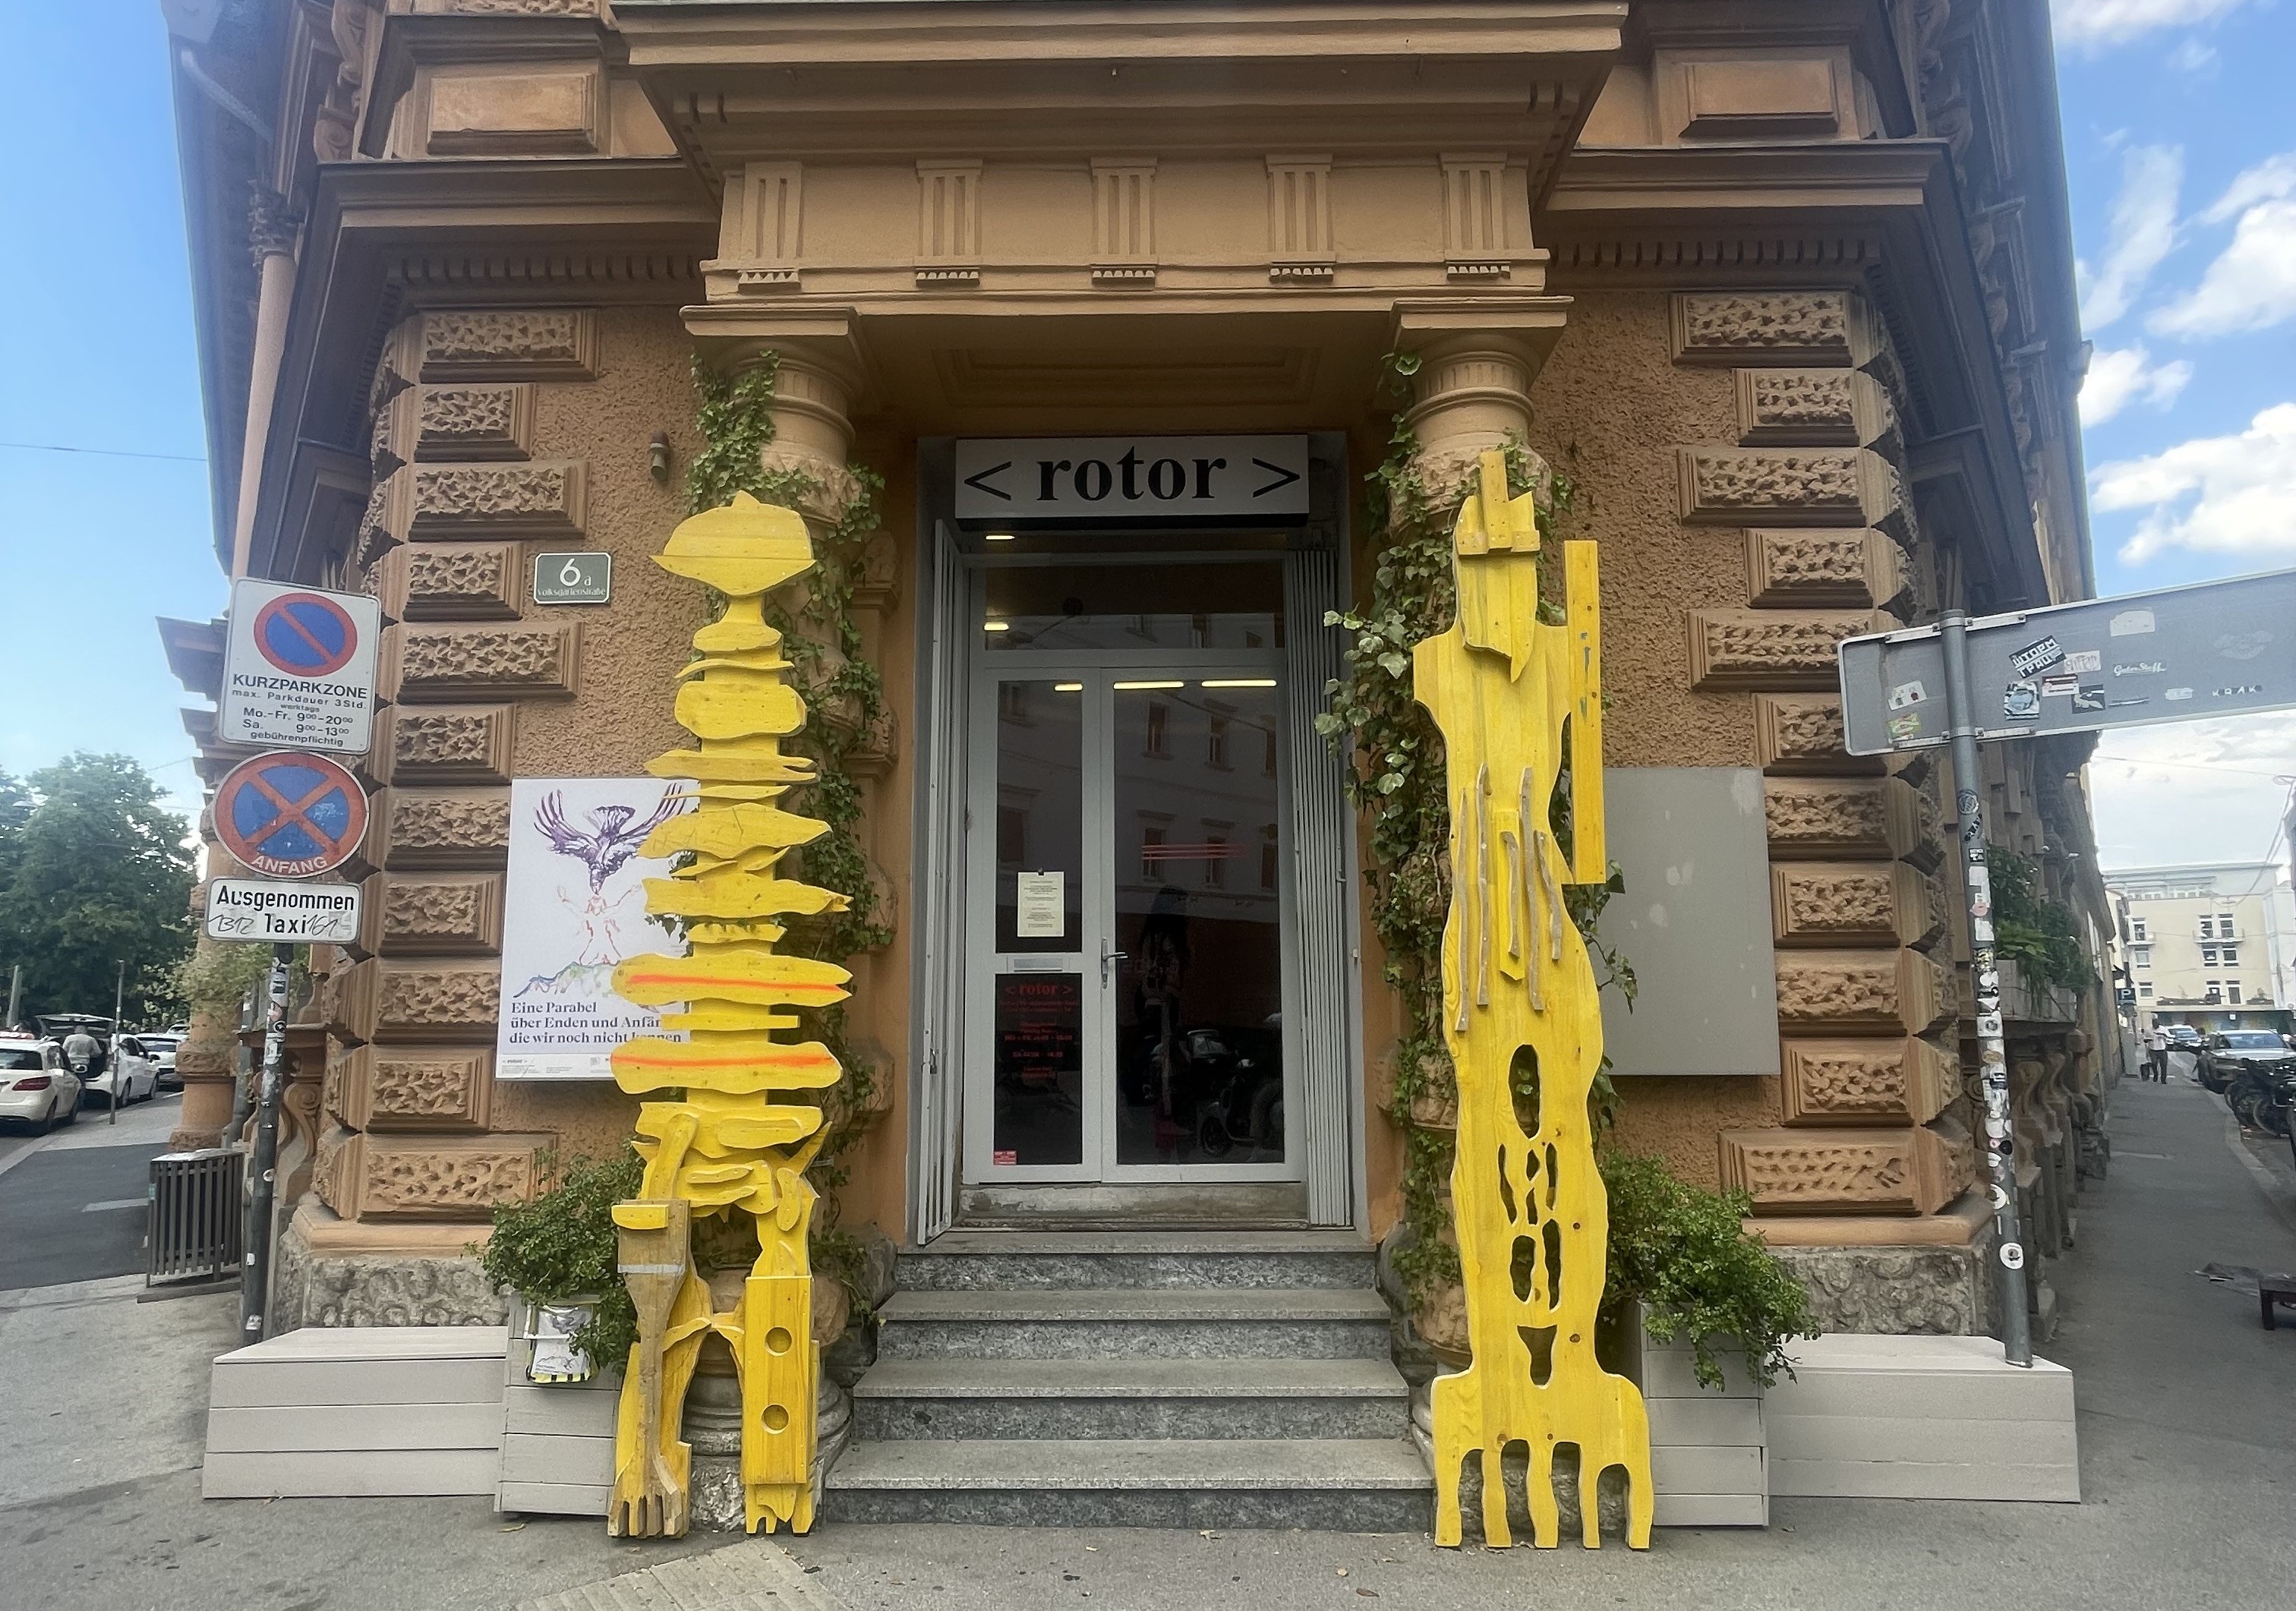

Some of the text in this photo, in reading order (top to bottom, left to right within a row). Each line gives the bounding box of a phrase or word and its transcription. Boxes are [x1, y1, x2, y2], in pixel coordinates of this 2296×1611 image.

[1036, 446, 1227, 501] rotor
[233, 674, 368, 698] KURZPARKZONE
[232, 689, 261, 698] max.
[267, 692, 329, 705] Parkdauer
[280, 704, 320, 713] werktags
[242, 718, 264, 729] Sa.
[251, 731, 344, 747] gebührenpflichtig
[251, 855, 327, 873] ANFANG
[216, 885, 355, 912] Ausgenommen
[263, 913, 307, 934] Taxi
[2121, 989, 2132, 999] P
[511, 1001, 597, 1014] Eine Parabel
[510, 1017, 542, 1028] über
[544, 1017, 588, 1028] Enden
[591, 1017, 618, 1028] und
[509, 1032, 530, 1044] die
[532, 1032, 555, 1043] wir
[557, 1032, 590, 1043] noch
[593, 1031, 629, 1043] nicht
